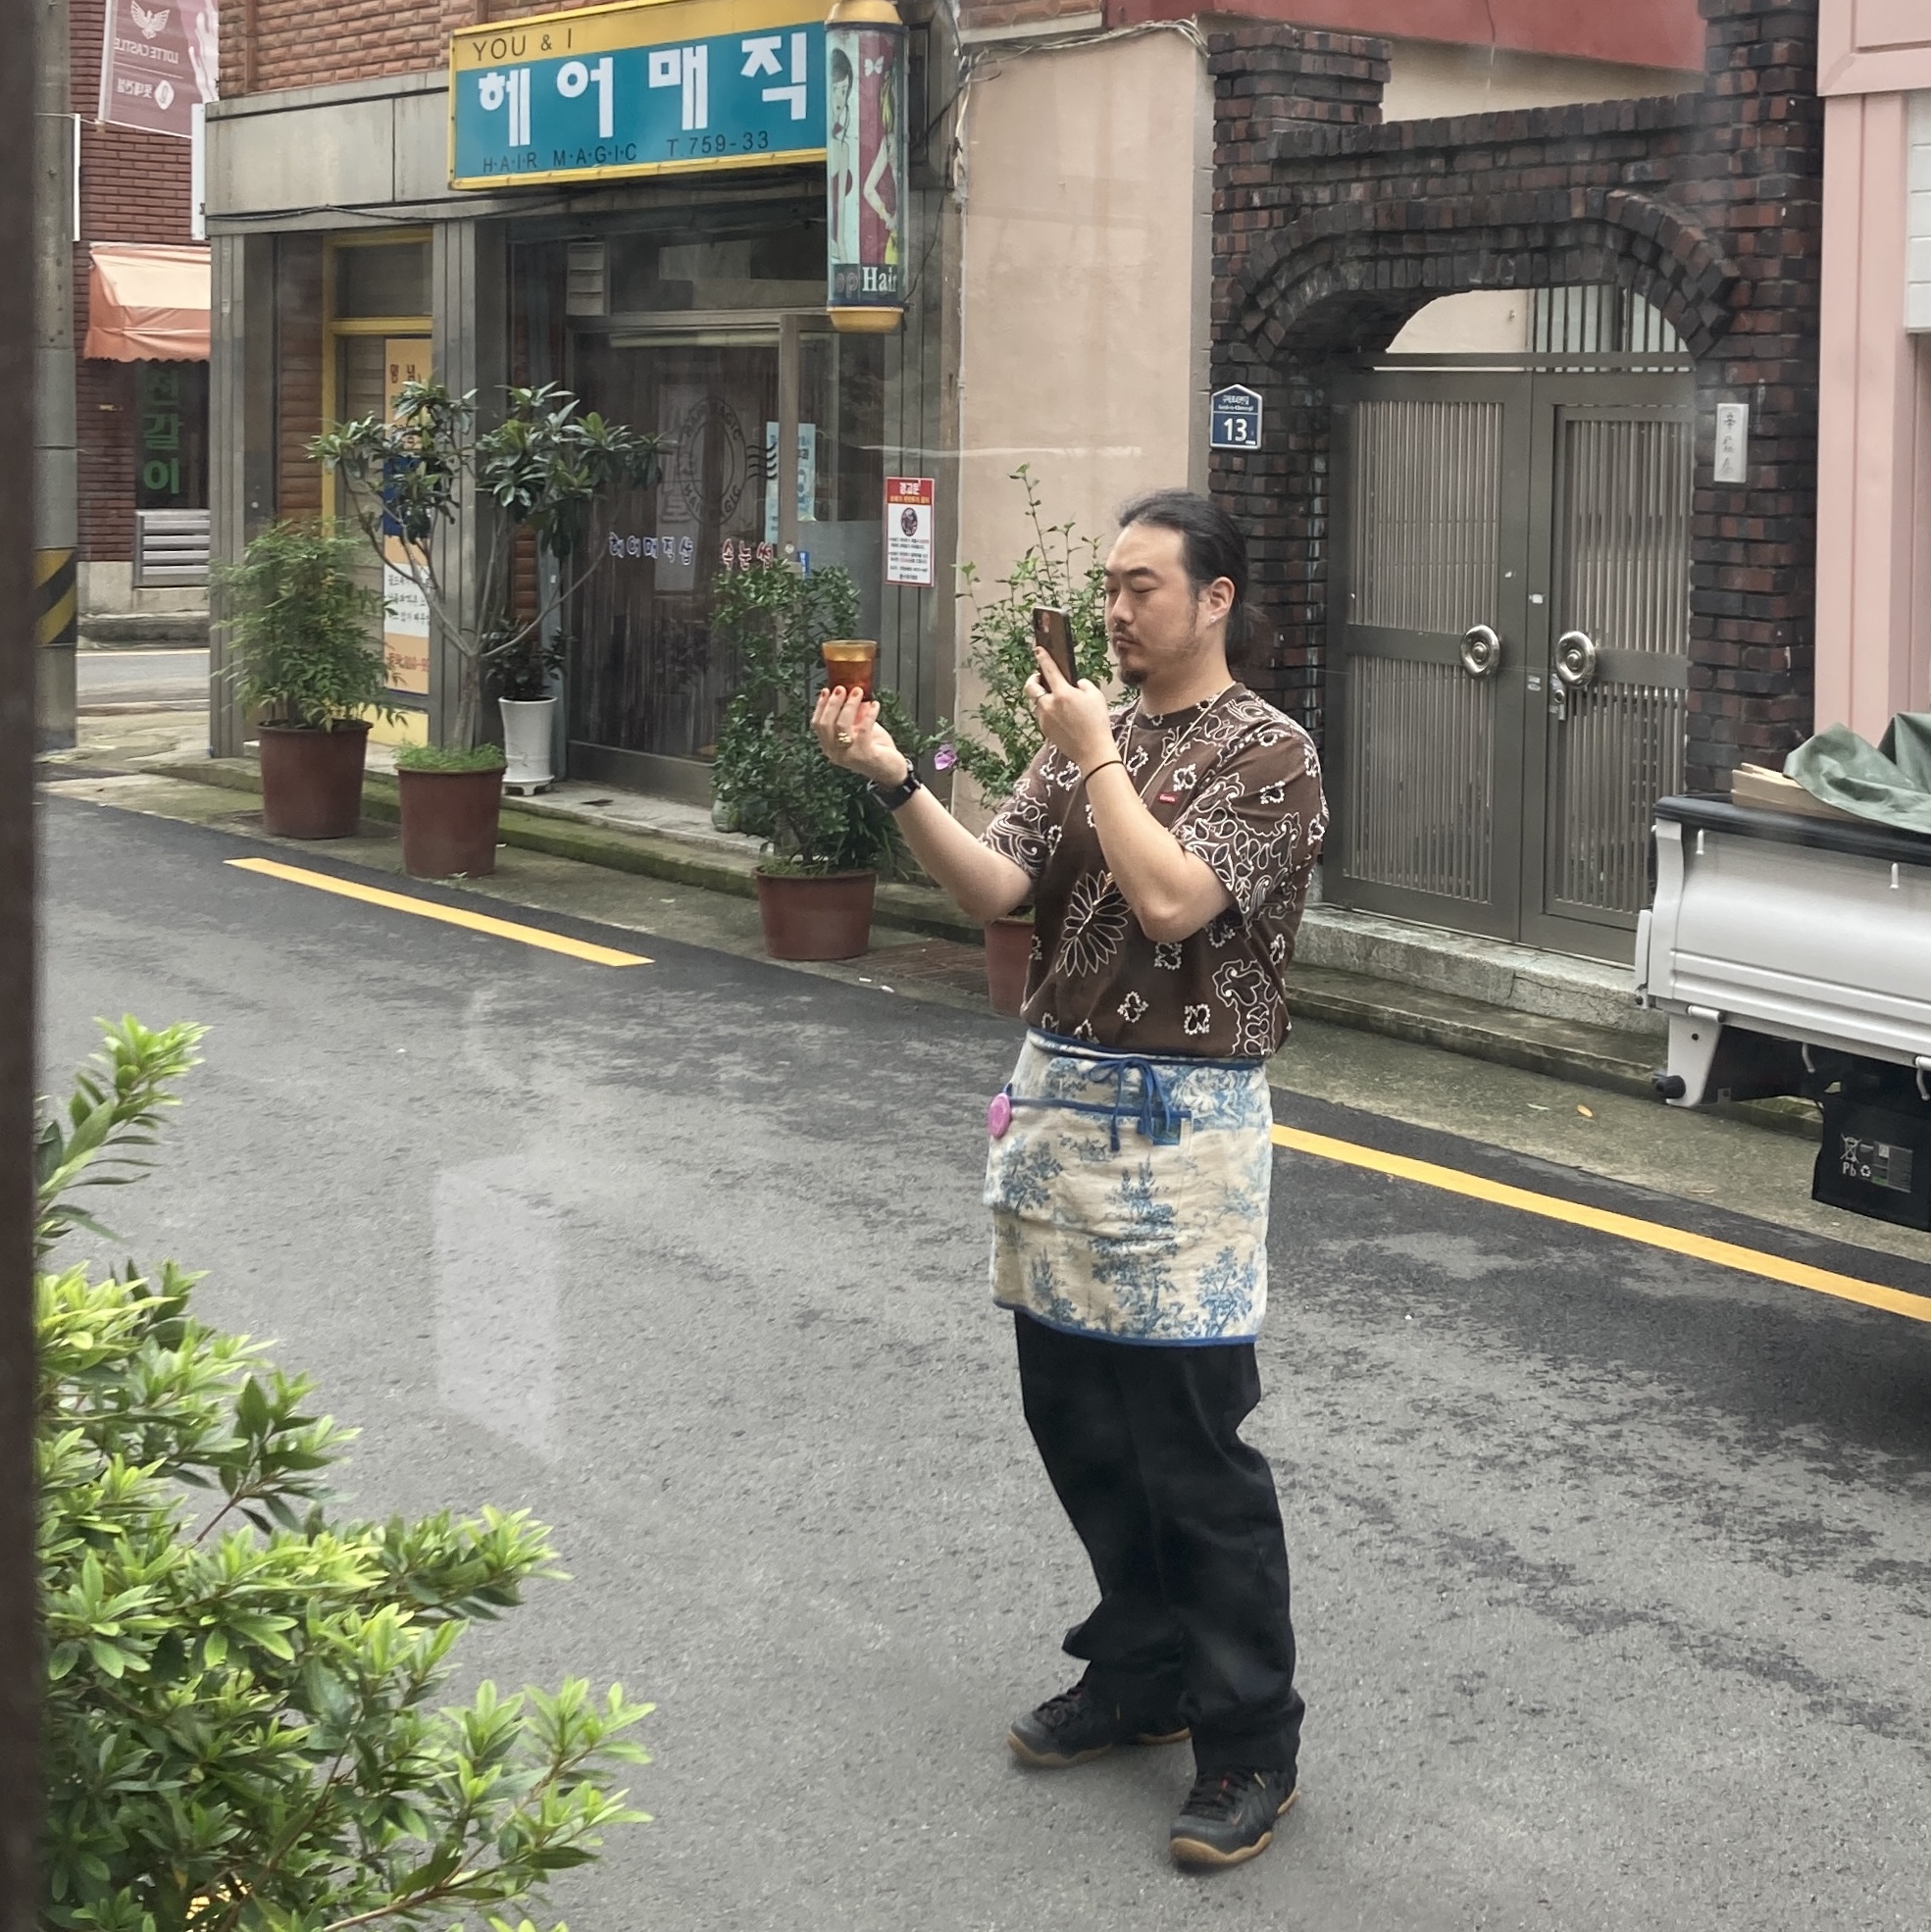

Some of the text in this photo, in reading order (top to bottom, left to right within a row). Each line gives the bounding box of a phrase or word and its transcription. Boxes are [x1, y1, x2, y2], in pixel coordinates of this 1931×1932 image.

[473, 34, 526, 62] YOU
[540, 33, 552, 52] &
[479, 32, 807, 147] 헤어매직
[862, 266, 897, 292] Hair
[1224, 418, 1247, 441] 13
[1843, 1161, 1856, 1177] Pb
